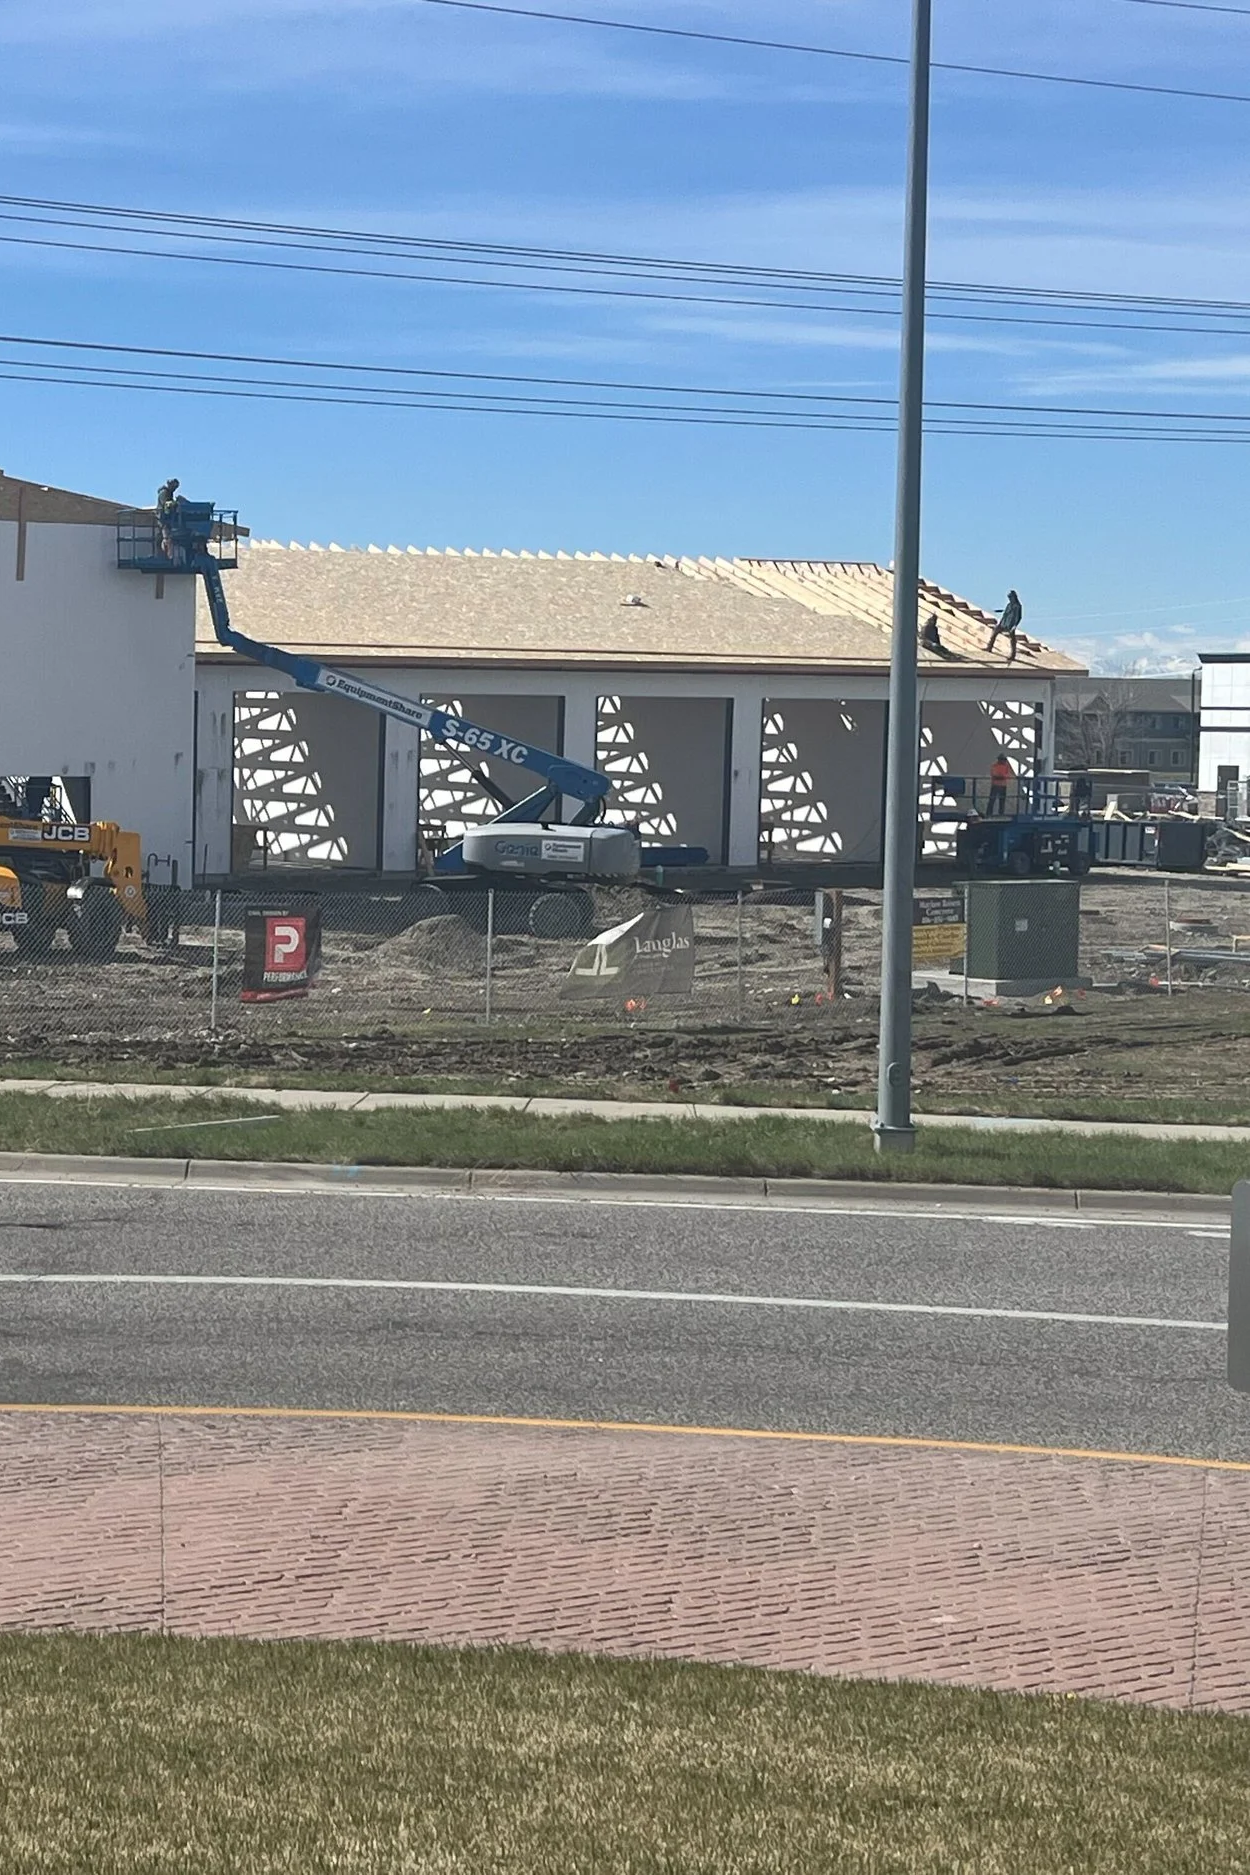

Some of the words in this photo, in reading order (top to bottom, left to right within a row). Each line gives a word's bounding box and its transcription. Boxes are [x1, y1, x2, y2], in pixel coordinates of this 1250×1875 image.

[336, 680, 423, 719] EquipmentShare
[441, 719, 494, 751] S-65
[493, 738, 529, 764] XC
[43, 825, 90, 841] JCB
[495, 840, 539, 857] Genie
[273, 926, 300, 964] P
[634, 931, 690, 958] Langlas
